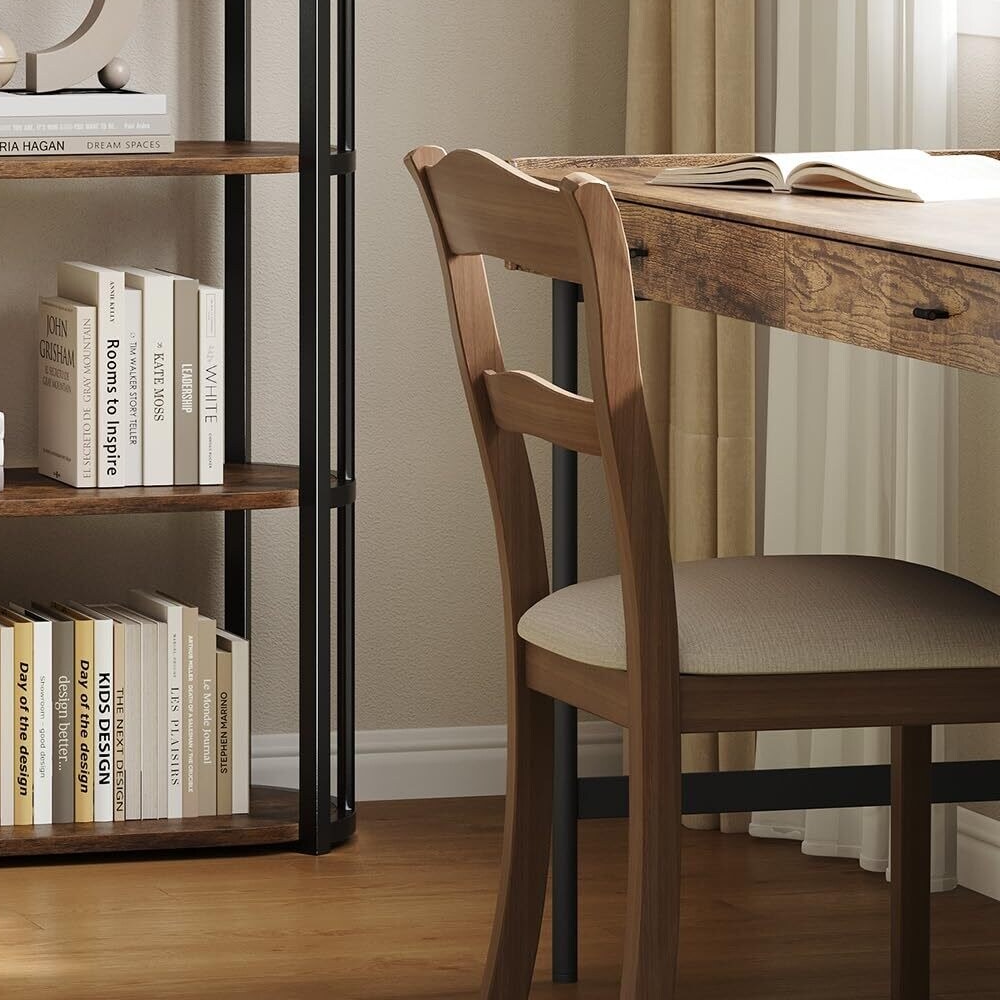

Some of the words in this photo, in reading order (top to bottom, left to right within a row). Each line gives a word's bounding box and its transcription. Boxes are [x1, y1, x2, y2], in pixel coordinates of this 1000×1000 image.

[23, 140, 65, 152] HAGAN
[87, 141, 121, 150] DREAM
[125, 141, 161, 149] SPACES
[46, 314, 68, 338] JOHN
[39, 339, 75, 368] GRISHAM
[82, 318, 92, 375] MOUNTAIN
[128, 342, 138, 356] TIM
[106, 339, 120, 394] Rooms
[128, 357, 138, 390] WALKER
[153, 352, 164, 385] KATE
[82, 378, 92, 403] GRAY
[128, 391, 138, 418] STORY
[181, 363, 192, 413] LEADERSHIP
[204, 364, 218, 423] WHITE
[82, 407, 92, 421] DE
[106, 398, 120, 416] to
[153, 388, 165, 422] MOSS
[82, 423, 92, 466] SECRETO
[103, 420, 120, 476] Inspire
[128, 419, 138, 446] TELLER
[82, 468, 92, 479] EL
[18, 661, 29, 692] Day
[78, 659, 90, 689] Day
[202, 679, 212, 690] Le
[19, 695, 29, 712] of
[39, 675, 47, 720] Showroom
[55, 675, 71, 719] design
[80, 693, 90, 710] of
[98, 672, 111, 714] KIDS
[116, 687, 124, 714] THE
[170, 686, 179, 713] LES
[80, 713, 90, 738] the
[202, 693, 212, 727] Monde
[220, 692, 228, 729] MARINO
[19, 716, 29, 740] the
[39, 728, 47, 750] good
[116, 719, 124, 756] NEXT
[57, 722, 70, 771] better...
[98, 718, 111, 785] DESIGN
[170, 719, 179, 786] PLAISIRS
[202, 728, 212, 764] Journal
[220, 731, 228, 774] STEPHEN
[18, 745, 29, 797] design
[38, 751, 47, 778] design
[78, 743, 90, 794] design
[116, 759, 124, 813] DESIGN
